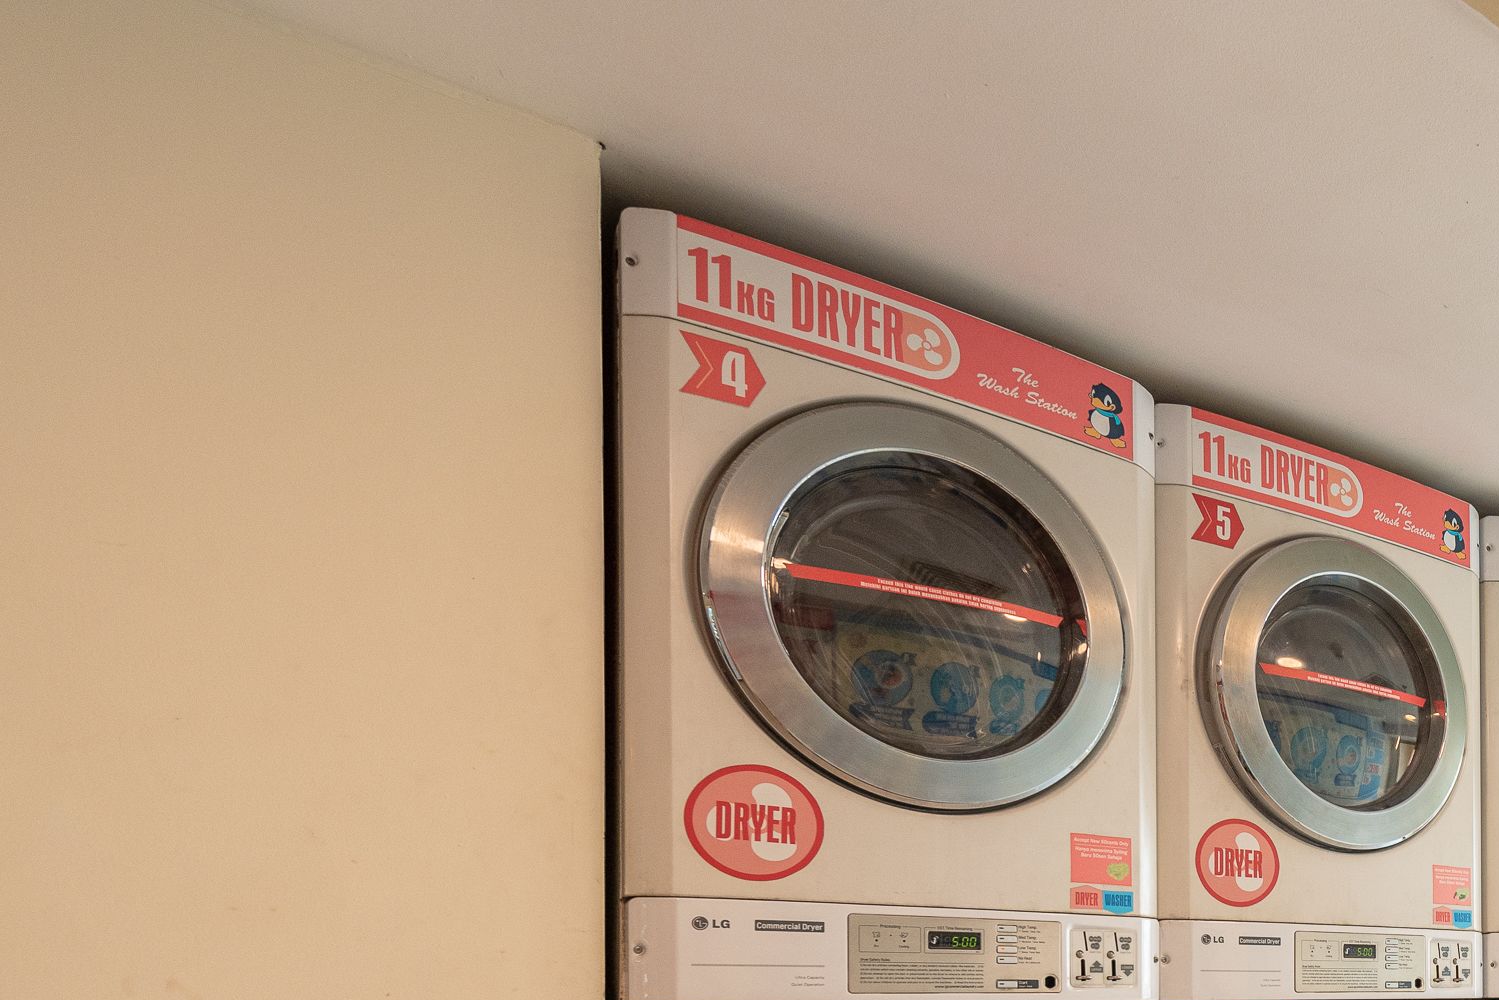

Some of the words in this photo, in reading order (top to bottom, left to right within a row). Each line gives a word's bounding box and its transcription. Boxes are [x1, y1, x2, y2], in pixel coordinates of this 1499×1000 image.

[687, 247, 775, 323] 11KG
[791, 272, 905, 363] DRYER
[721, 351, 748, 397] 4
[1011, 367, 1039, 388] The
[976, 373, 1020, 399] Wash
[1024, 391, 1078, 420] Station
[1198, 430, 1252, 485] 11KG
[1260, 443, 1330, 507] DRYER
[1215, 503, 1232, 541] 5
[1372, 508, 1402, 529] Wash
[1402, 519, 1437, 541] Station
[1394, 502, 1413, 518] The
[715, 800, 796, 845] DRYER
[1213, 847, 1263, 879] DRYER
[1075, 891, 1099, 907] DRYER
[1104, 893, 1132, 907] WASHER
[712, 919, 731, 929] LG
[756, 921, 801, 932] Commercial
[801, 922, 824, 932] Dryer
[1213, 936, 1225, 944] LG
[1239, 937, 1267, 945] Commercial
[1267, 937, 1280, 945] Dryer
